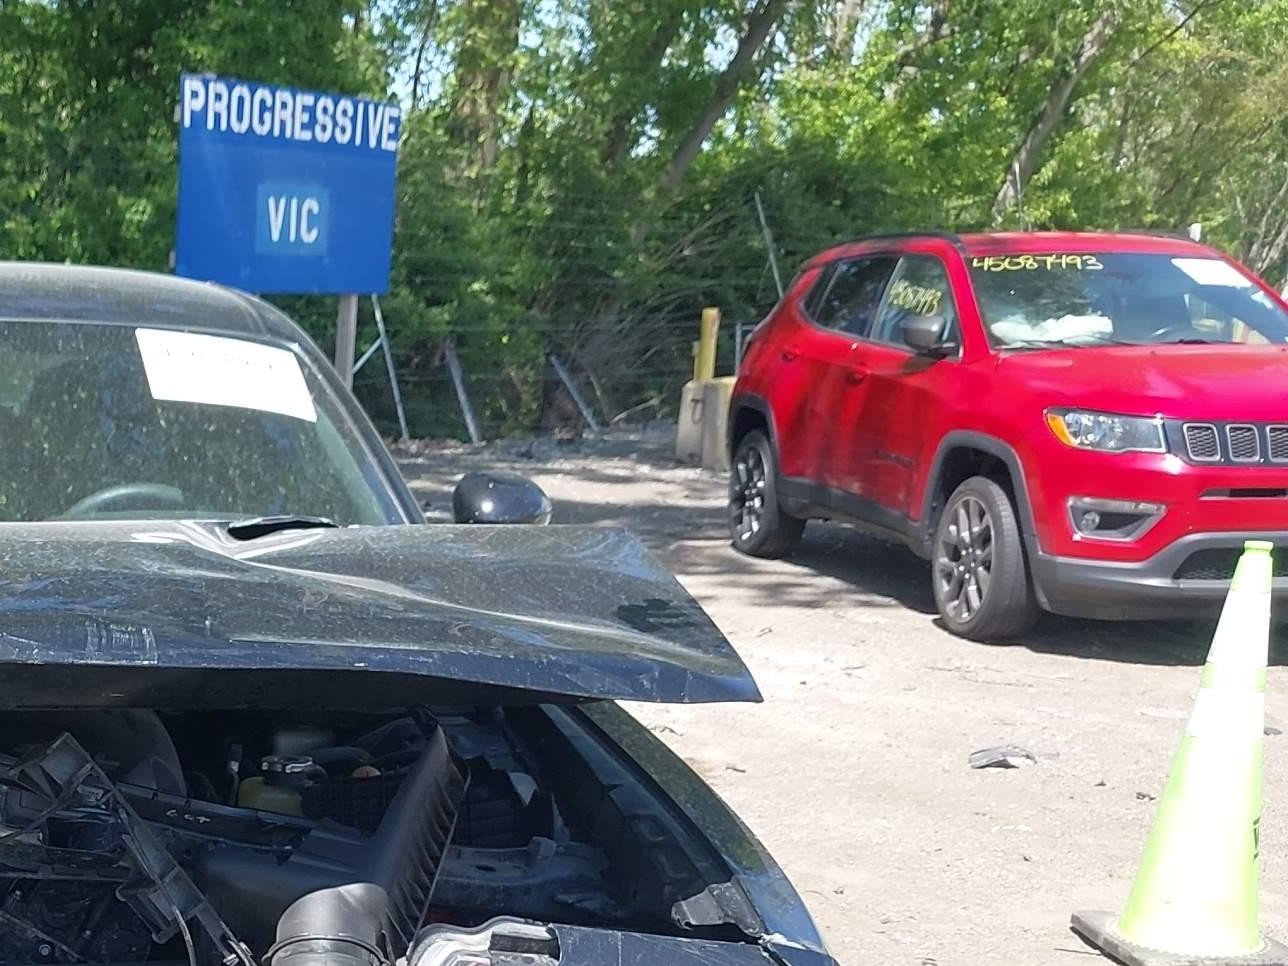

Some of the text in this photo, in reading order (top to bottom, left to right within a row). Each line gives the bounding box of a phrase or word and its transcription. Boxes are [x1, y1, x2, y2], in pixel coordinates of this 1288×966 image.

[183, 78, 399, 152] PROGRESSIVE
[267, 195, 319, 244] VIC
[972, 254, 1104, 272] 45087493
